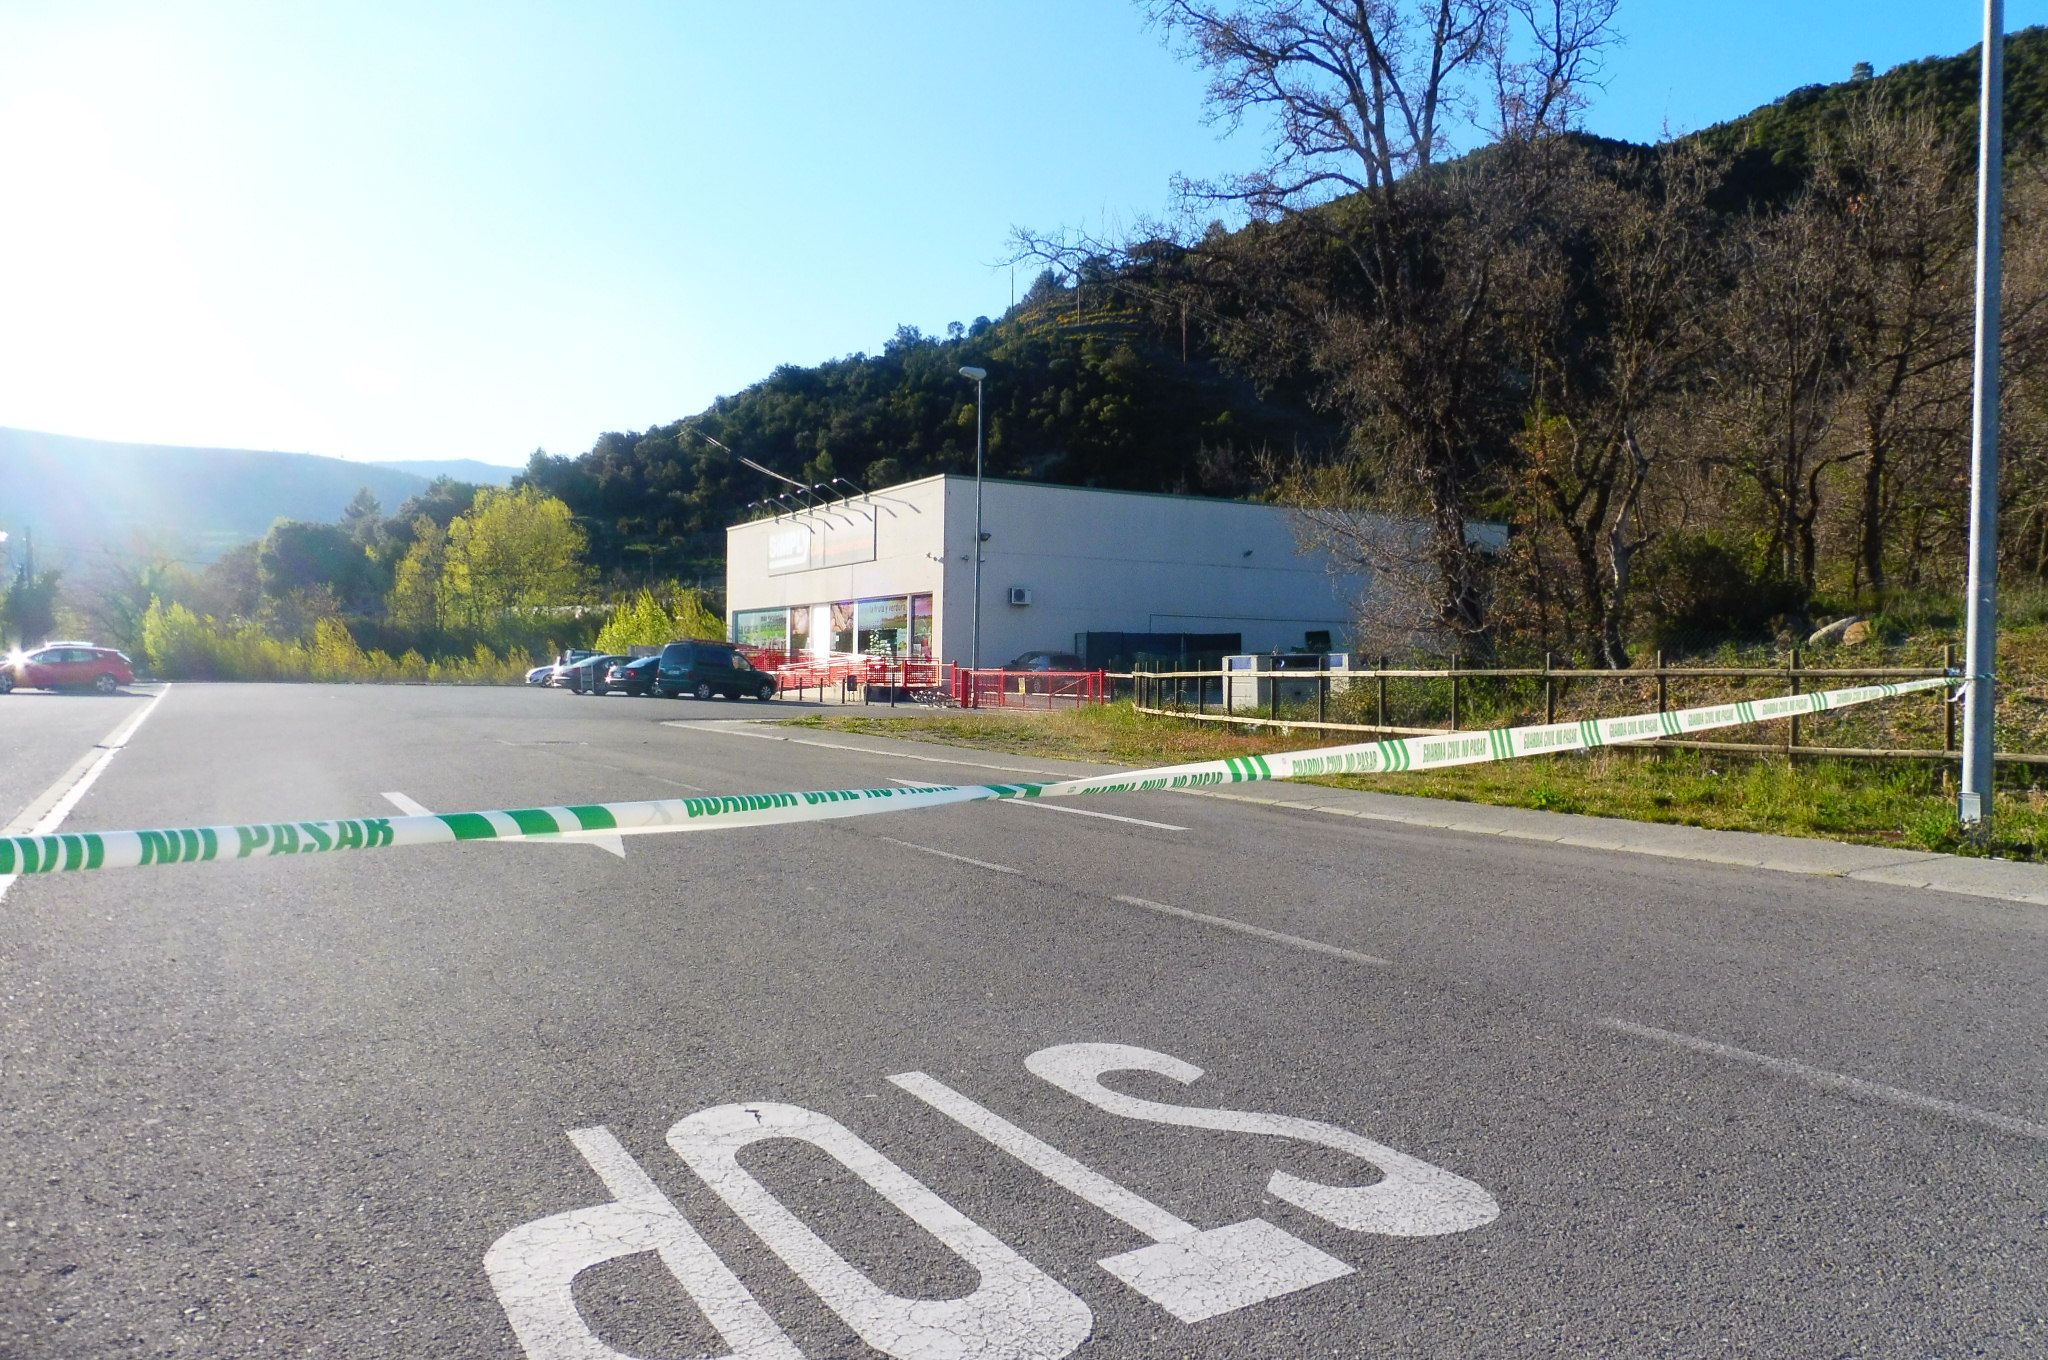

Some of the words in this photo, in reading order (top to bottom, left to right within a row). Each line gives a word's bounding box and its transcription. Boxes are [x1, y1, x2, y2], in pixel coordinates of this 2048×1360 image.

[1423, 741, 1446, 763] GUARDIA
[1447, 740, 1460, 760] CIVIL
[1461, 739, 1469, 758] NO
[1470, 737, 1487, 756] PASAR
[1523, 731, 1543, 749] GUARDIA
[1544, 730, 1555, 747] CIVIL
[1563, 728, 1577, 743] PASAR
[1292, 756, 1325, 776] GUARDIA
[1326, 754, 1343, 774] CIVIL
[1345, 753, 1356, 772] NO
[1356, 750, 1378, 771] PASAR
[233, 818, 394, 859] PASAR
[483, 1042, 1500, 1360] STOP
